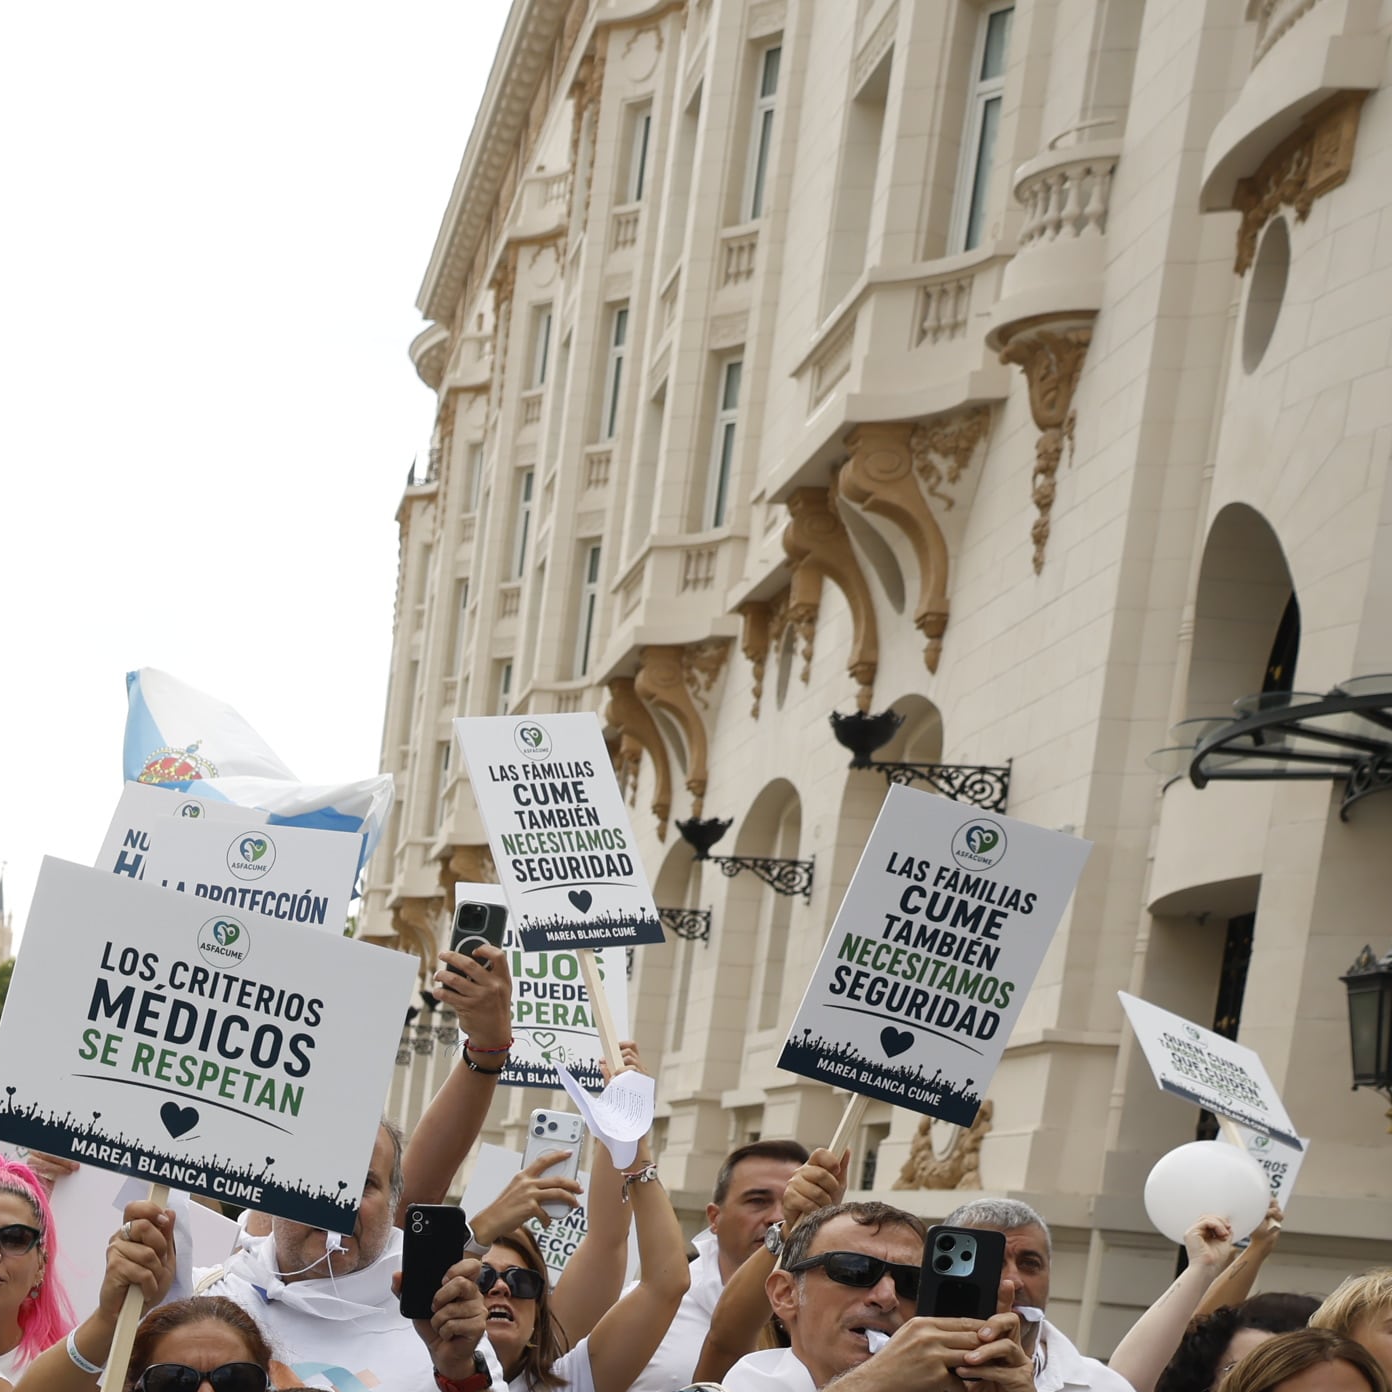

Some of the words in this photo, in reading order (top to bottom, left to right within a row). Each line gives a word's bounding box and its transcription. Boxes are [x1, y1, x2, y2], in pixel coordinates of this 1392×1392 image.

[488, 764, 519, 782] LAS
[513, 781, 589, 807] CUME
[515, 805, 600, 830] TAMBIÉN
[501, 828, 627, 855] NECESITAMOS
[955, 849, 993, 865] ASFACUME
[231, 863, 267, 871] ASFACUME
[512, 853, 634, 883] SEGURIDAD
[886, 851, 931, 882] LAS
[900, 885, 1008, 940] CUME
[200, 943, 243, 961] ASFACUME
[881, 914, 1001, 971] TAMBIÉN
[100, 941, 160, 982] LOS
[169, 961, 324, 1028] CRITERIOS
[837, 933, 1015, 1009] NECESITAMOS
[828, 965, 1000, 1040] SEGURIDAD
[86, 977, 316, 1078] MÉDICOS
[78, 1028, 123, 1068] SE
[130, 1042, 305, 1118] RESPETAN
[817, 1058, 857, 1079] MAREA
[859, 1071, 906, 1096] BLANCA
[907, 1087, 942, 1107] CUME
[71, 1138, 133, 1168] MAREA
[138, 1156, 208, 1189] BLANCA
[213, 1177, 263, 1203] CUME
